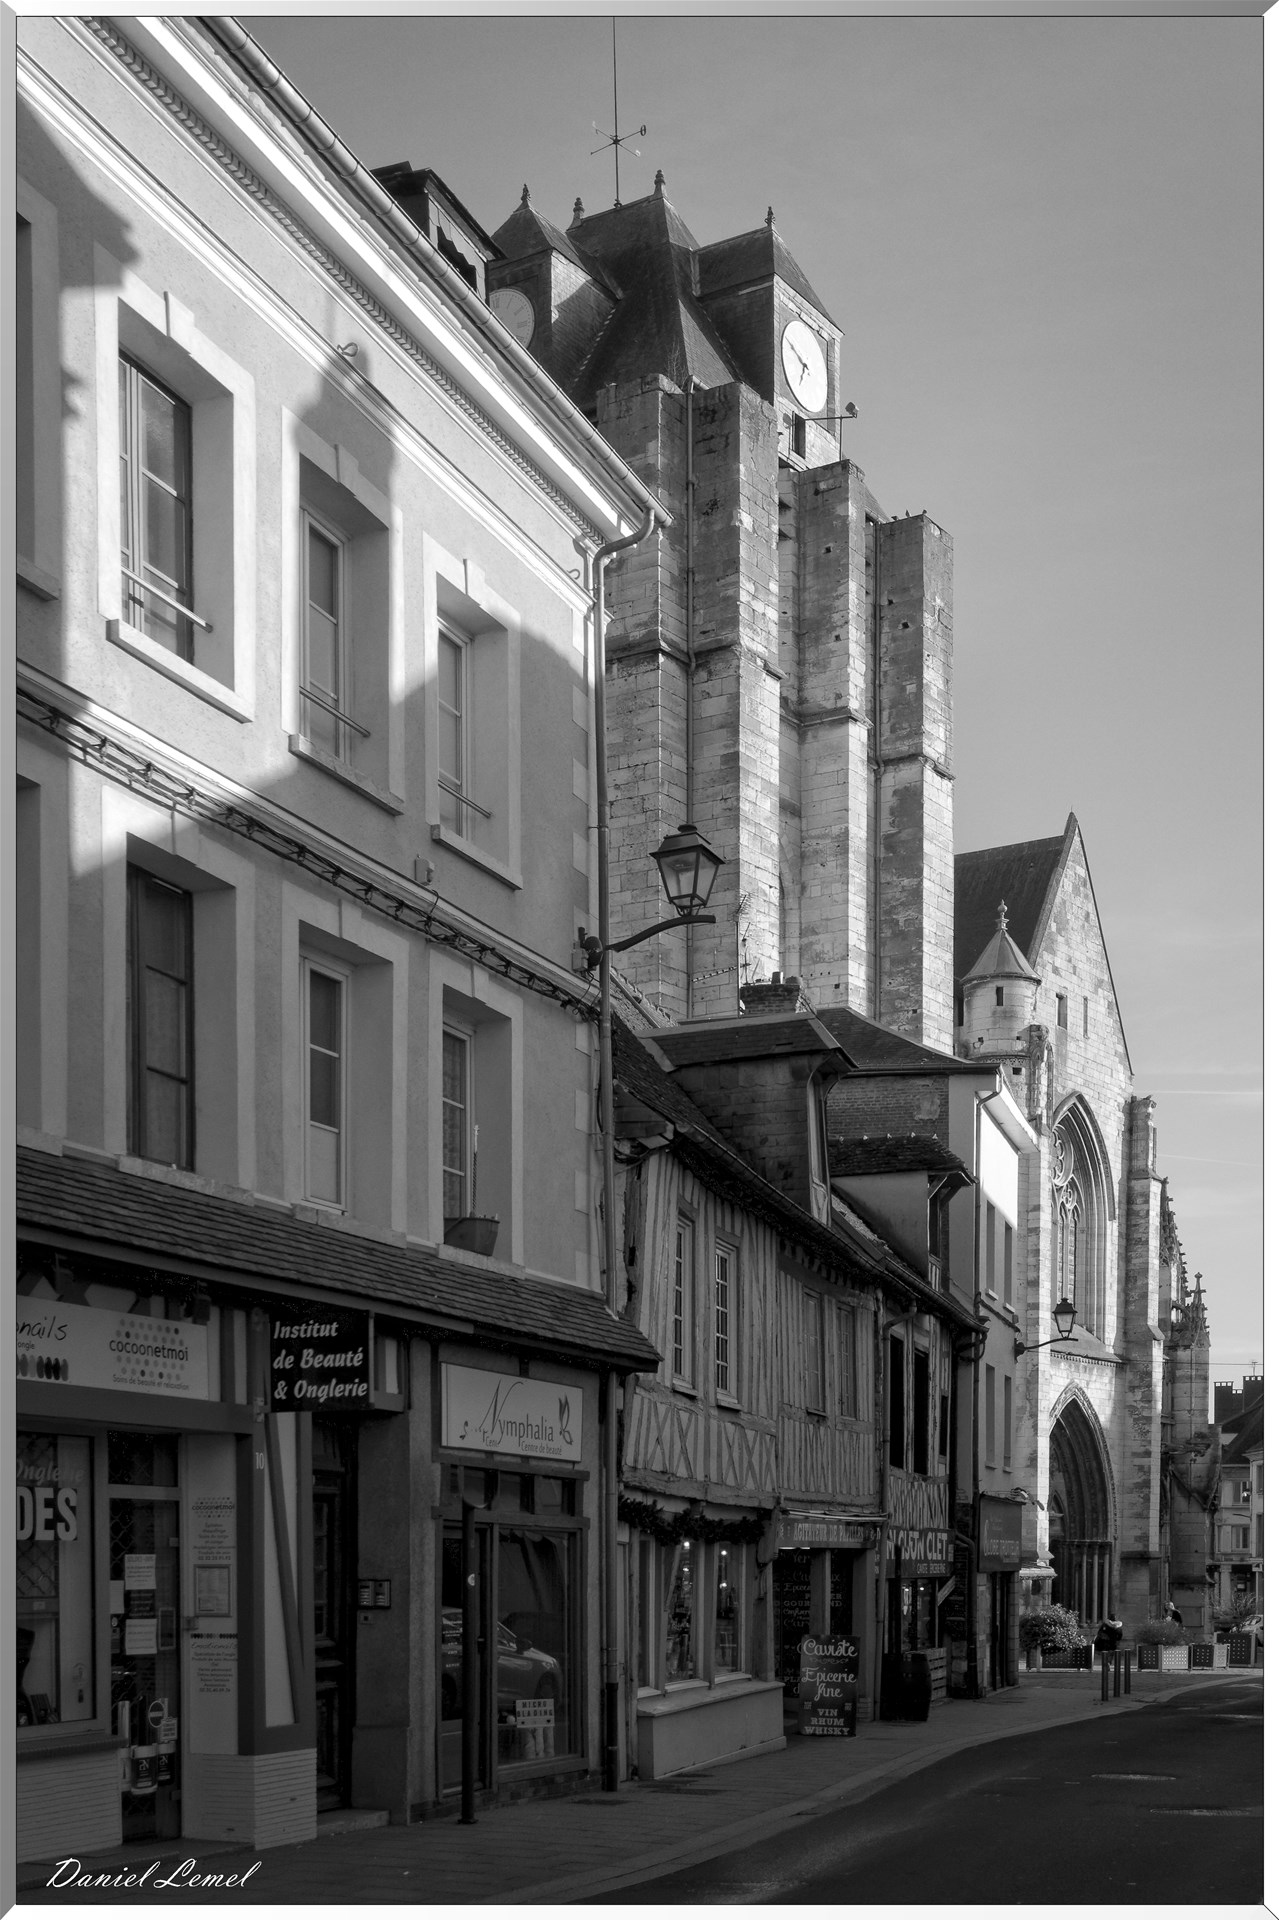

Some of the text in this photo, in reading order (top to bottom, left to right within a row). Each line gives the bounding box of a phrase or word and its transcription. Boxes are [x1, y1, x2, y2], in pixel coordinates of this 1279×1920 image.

[273, 1320, 339, 1339] Institut
[109, 1339, 189, 1362] cocoonetmoi
[272, 1347, 364, 1370] de Beauté
[273, 1378, 368, 1403] & Onglerie
[479, 1379, 555, 1447] Nymphalia
[255, 1451, 265, 1470] 10
[16, 1486, 78, 1541] DES
[926, 1531, 948, 1560] CLET
[803, 1638, 858, 1657] Caviste
[801, 1666, 857, 1687] Epicerie
[516, 1710, 553, 1718] BLADING
[522, 1701, 547, 1709] MICRO
[817, 1708, 839, 1717] VIN
[804, 1726, 850, 1736] WHISKY
[810, 1717, 845, 1726] RHUM
